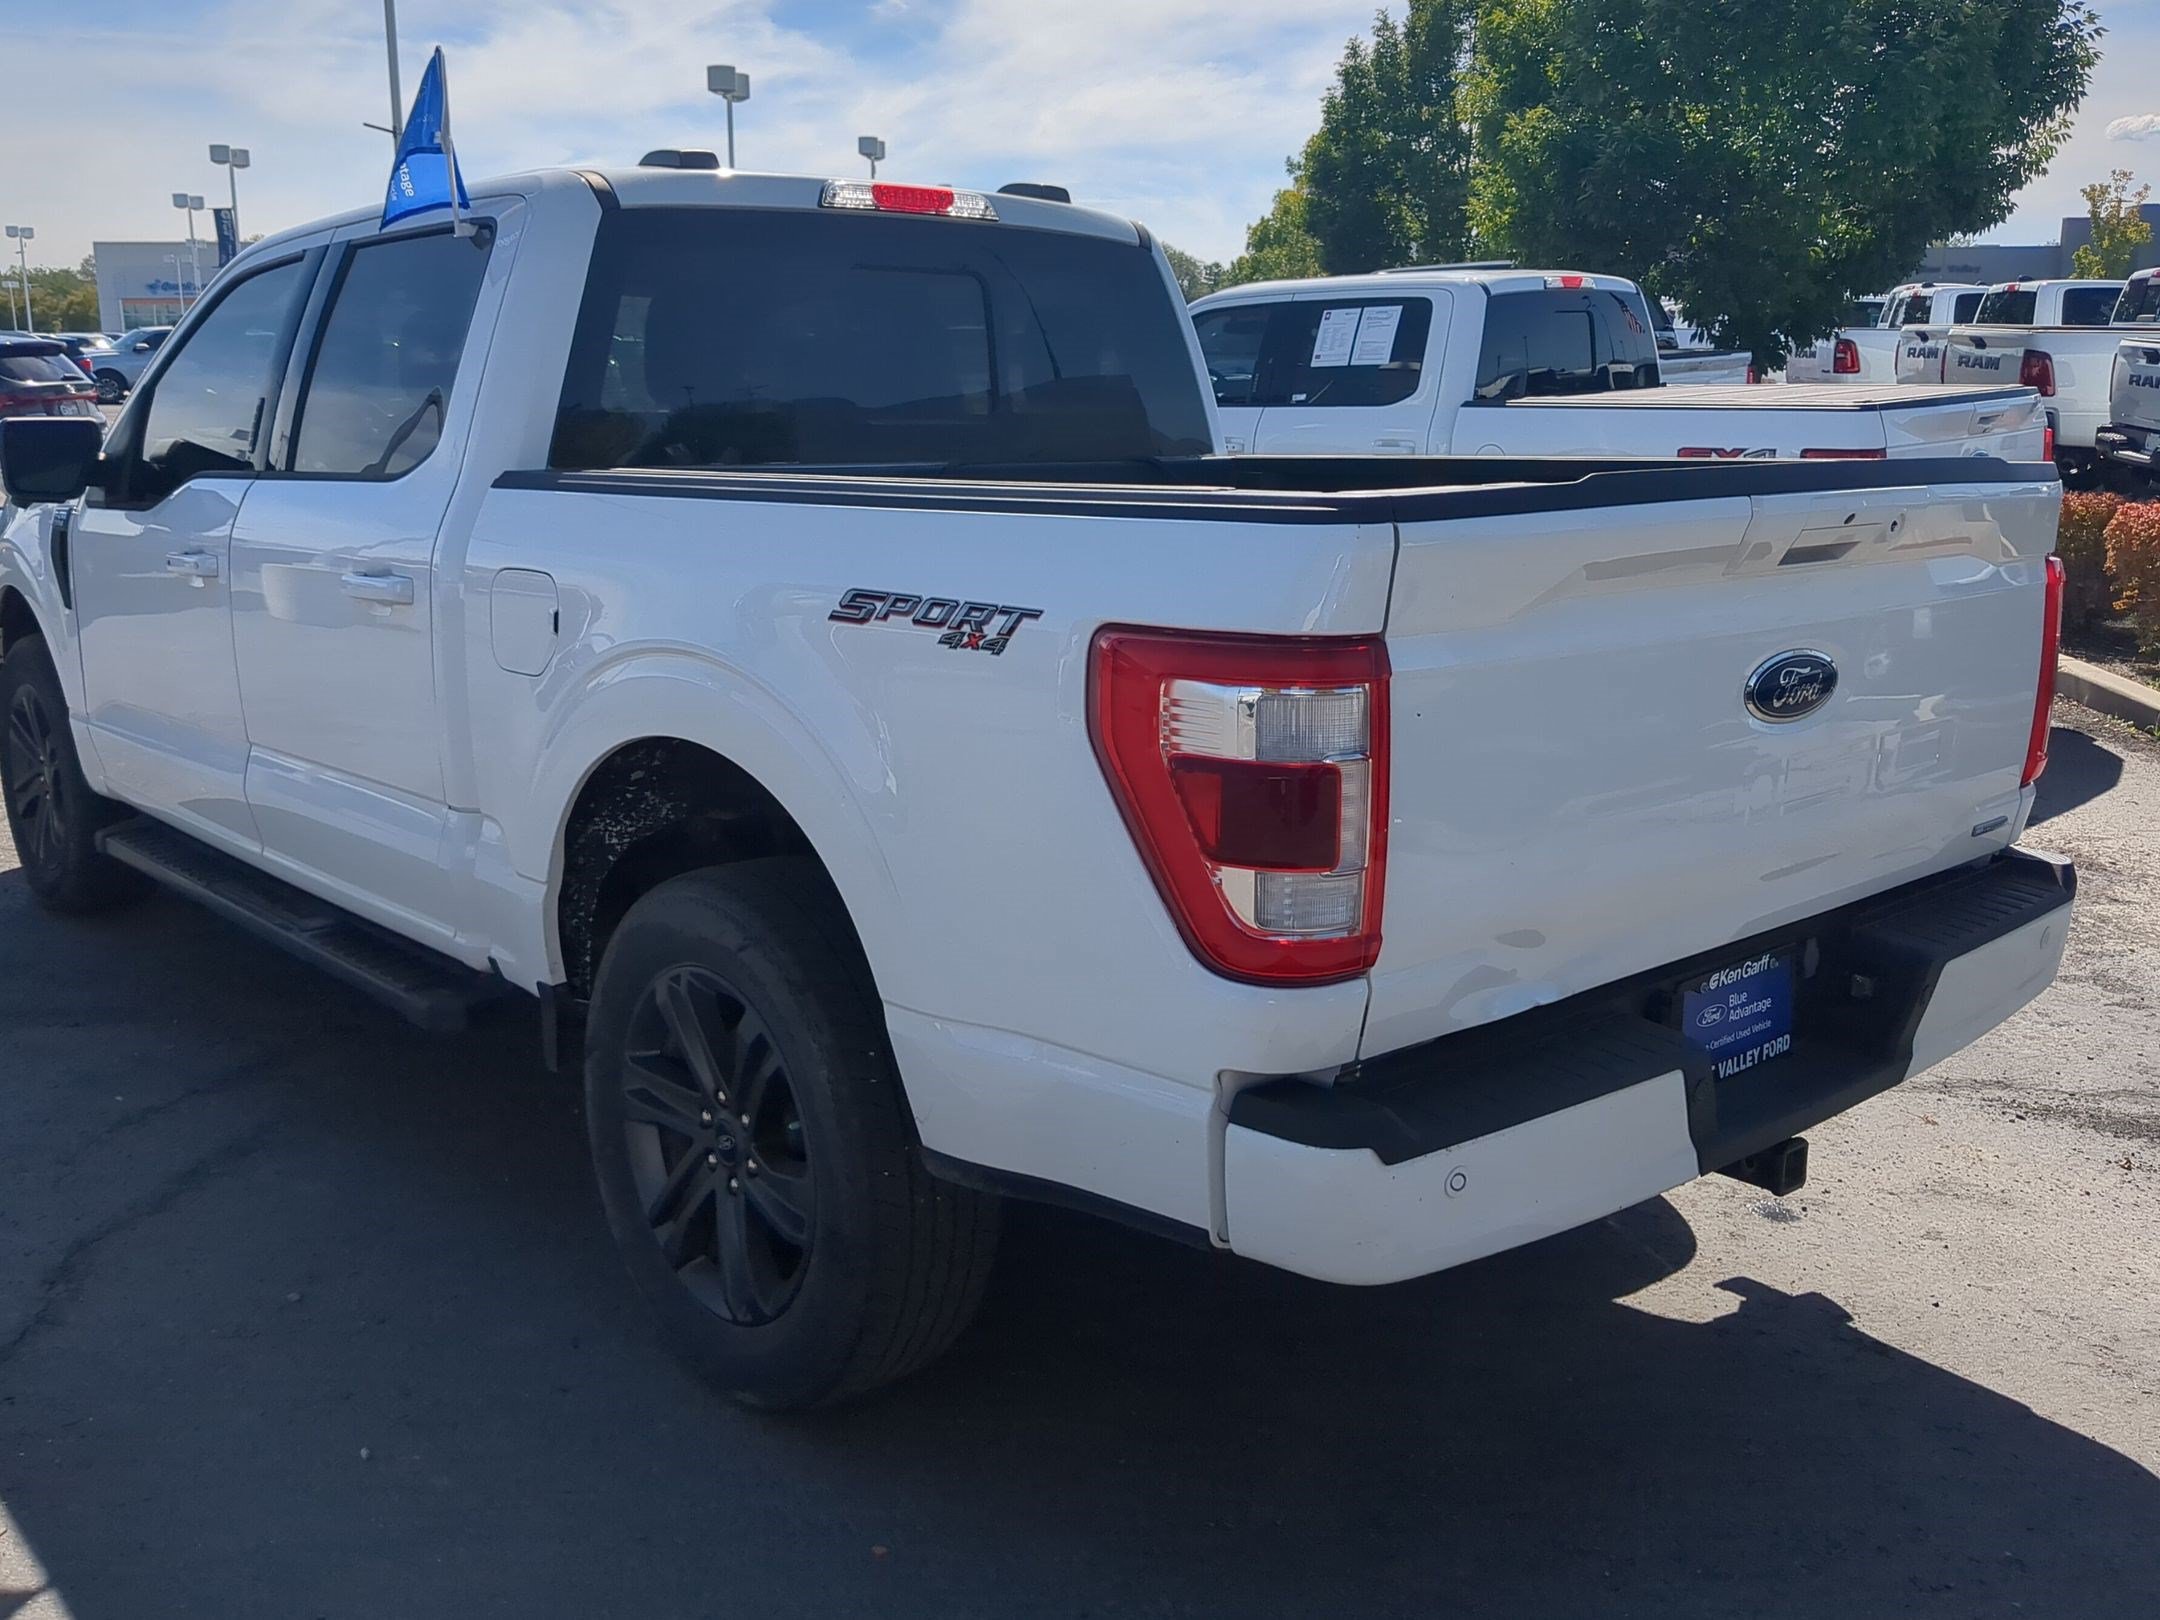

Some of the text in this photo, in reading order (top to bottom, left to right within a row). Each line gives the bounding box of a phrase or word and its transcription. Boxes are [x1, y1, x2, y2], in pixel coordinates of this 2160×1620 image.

[1906, 346, 1940, 359] RAM
[1957, 354, 2001, 371] RAM
[827, 588, 1045, 637] SPORT
[1772, 666, 1824, 708] Ford
[1728, 992, 1748, 1007] Blue
[1728, 997, 1772, 1023] Advantage
[1701, 1007, 1722, 1025] Ford
[1717, 1033, 1791, 1079] VALLEY FORD
